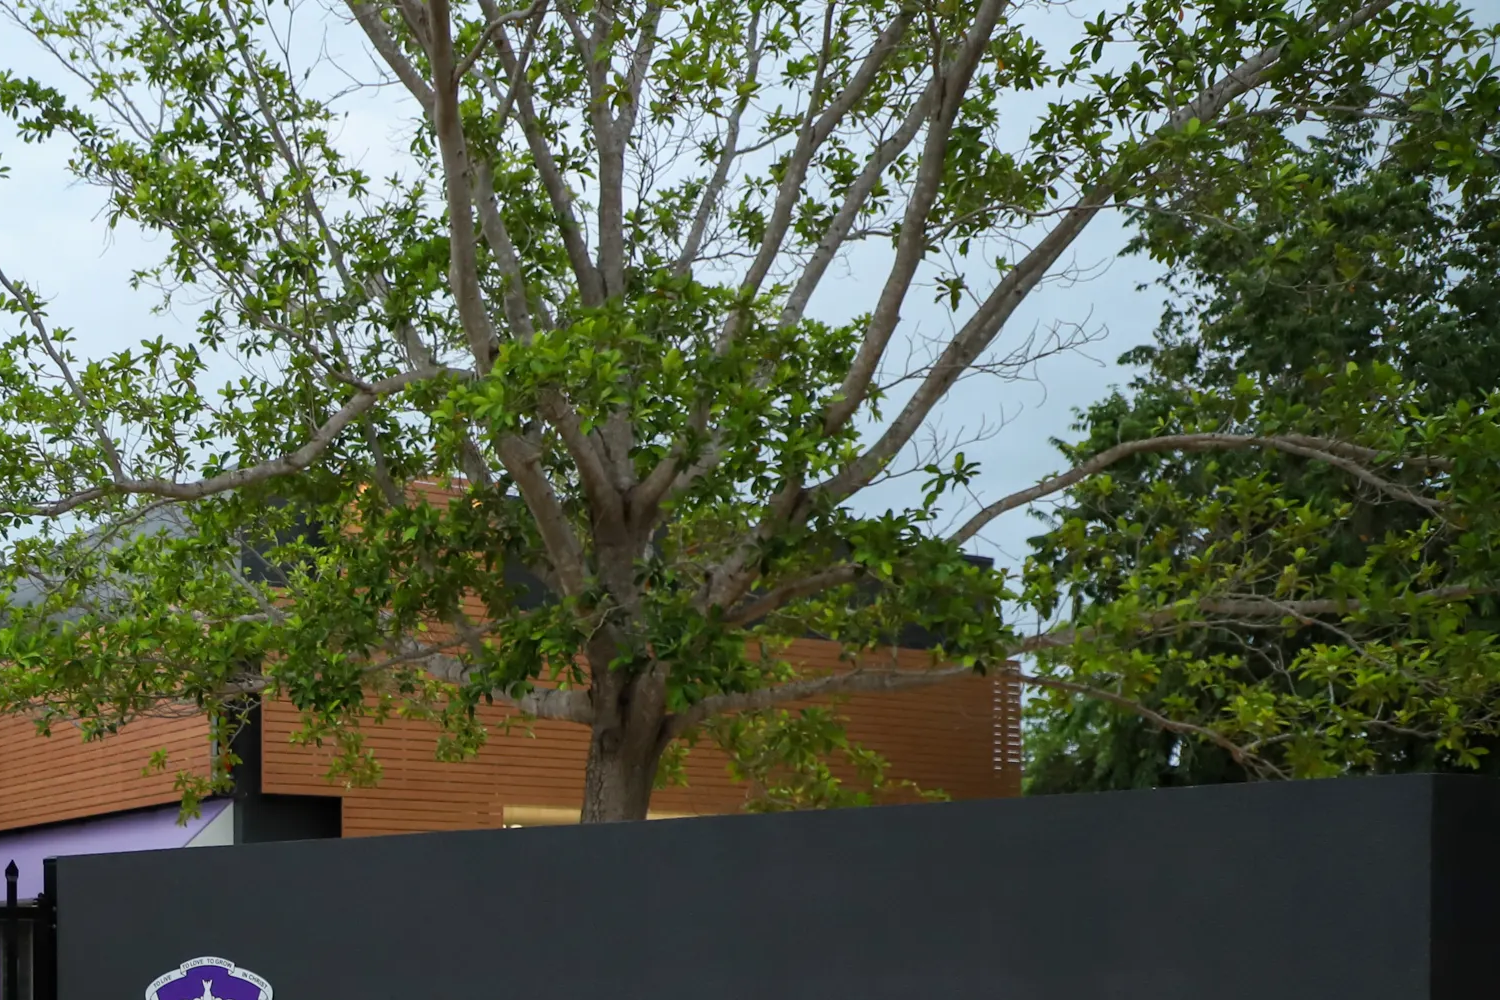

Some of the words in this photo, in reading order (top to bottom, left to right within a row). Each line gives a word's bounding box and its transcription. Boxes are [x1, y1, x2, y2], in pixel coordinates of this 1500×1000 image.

[161, 974, 172, 983] LIVE
[182, 962, 190, 970] TO
[190, 959, 204, 967] LOVE
[215, 958, 232, 969] GROW
[248, 974, 268, 989] CHRIST
